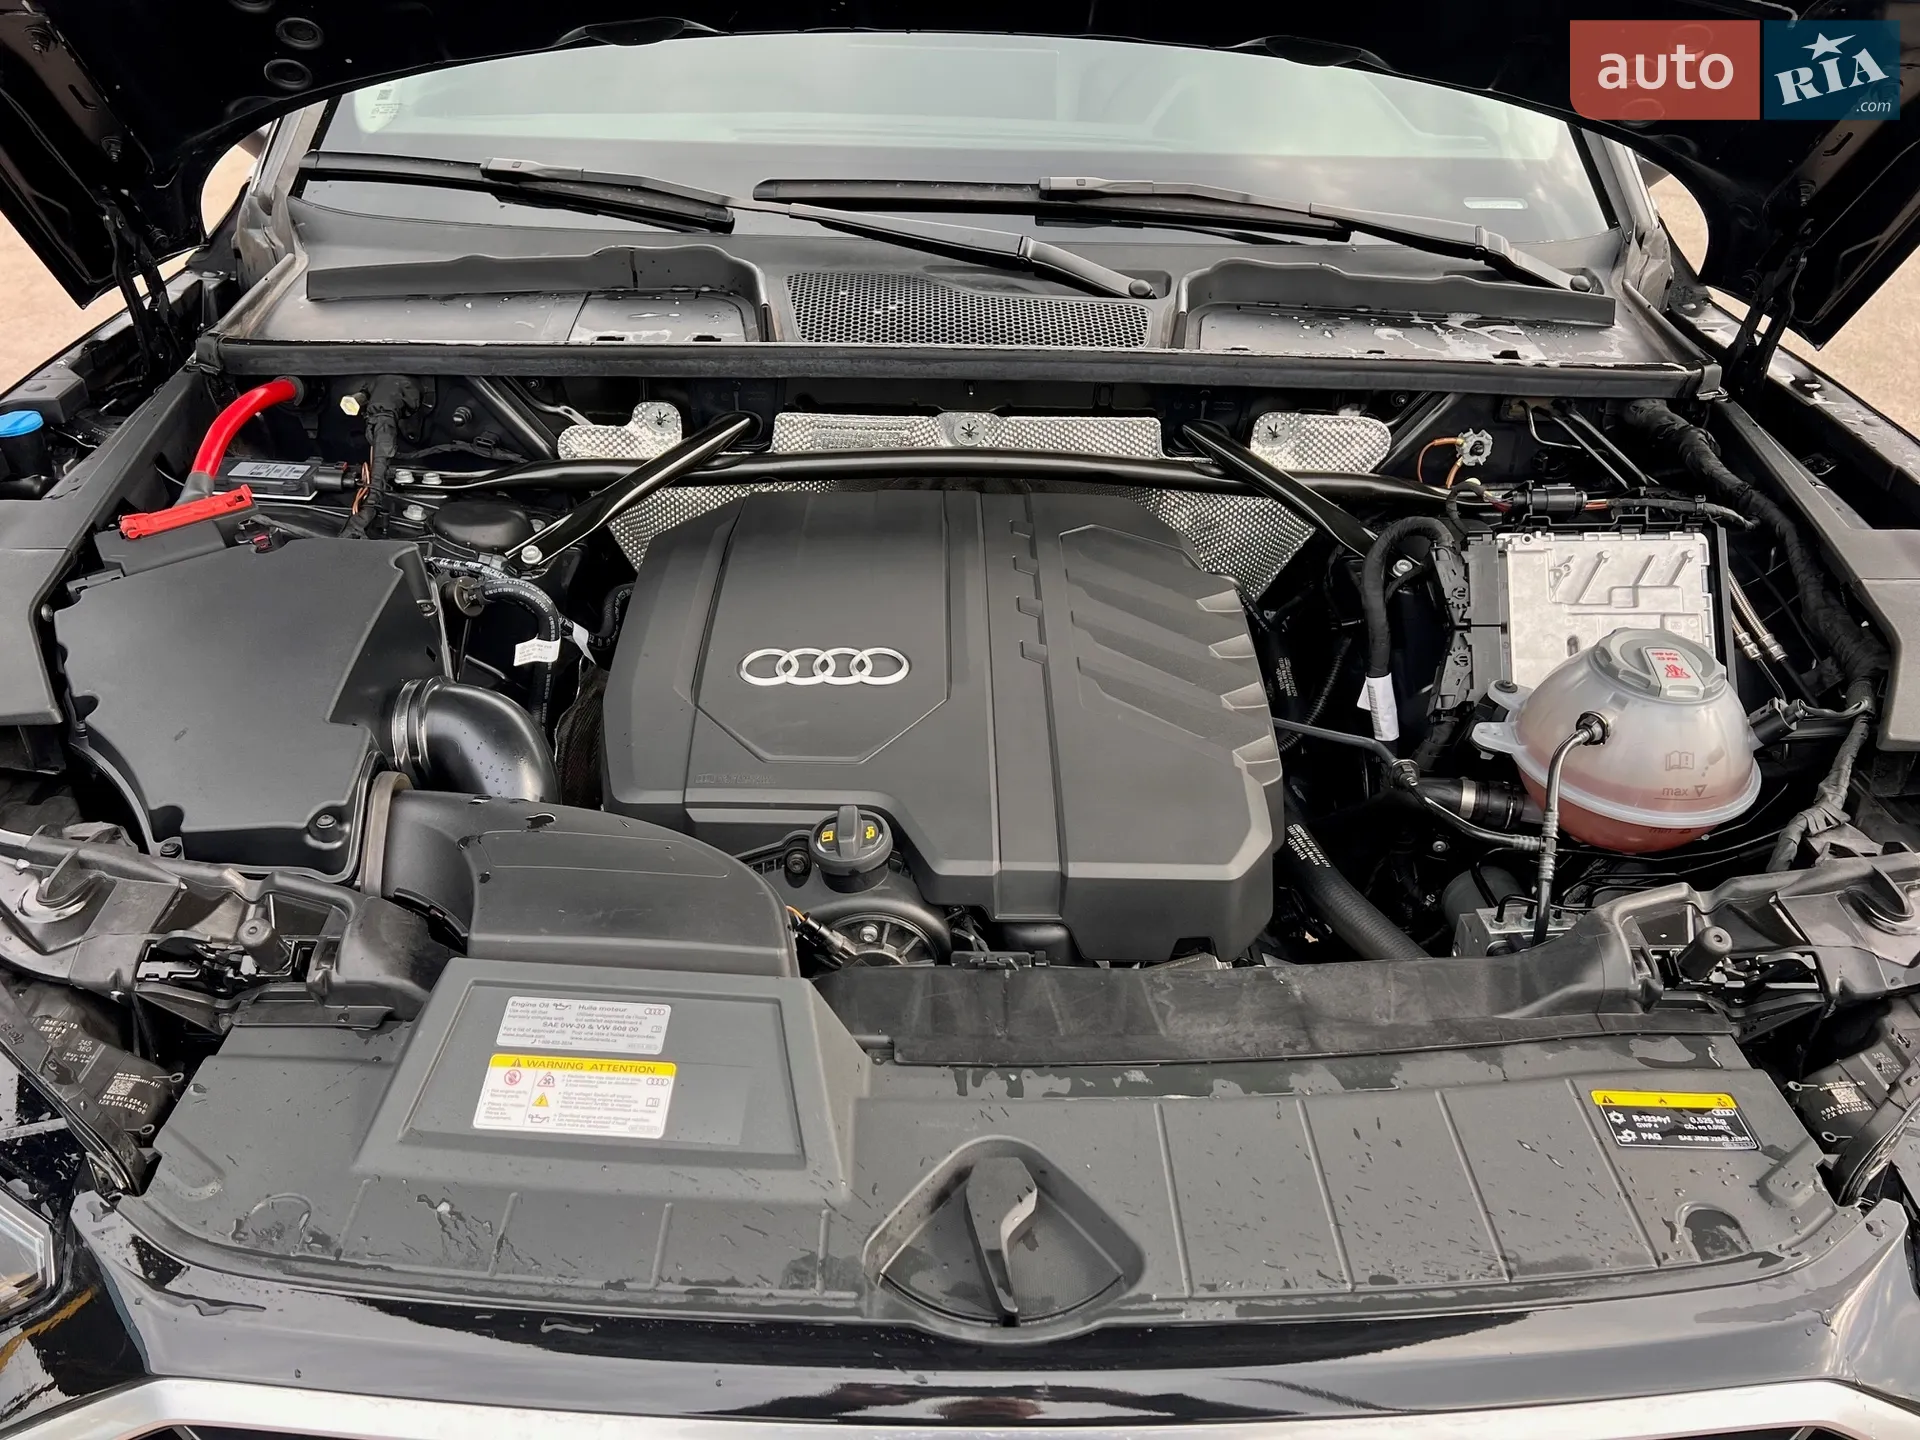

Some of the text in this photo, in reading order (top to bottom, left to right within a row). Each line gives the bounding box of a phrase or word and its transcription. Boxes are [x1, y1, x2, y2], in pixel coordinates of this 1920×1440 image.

[1662, 787, 1688, 796] max
[526, 1059, 656, 1074] WARNING ATTENTION
[1632, 1114, 1671, 1124] R-1234yf
[1714, 1117, 1727, 1125] kg
[1640, 1132, 1663, 1140] PAG
